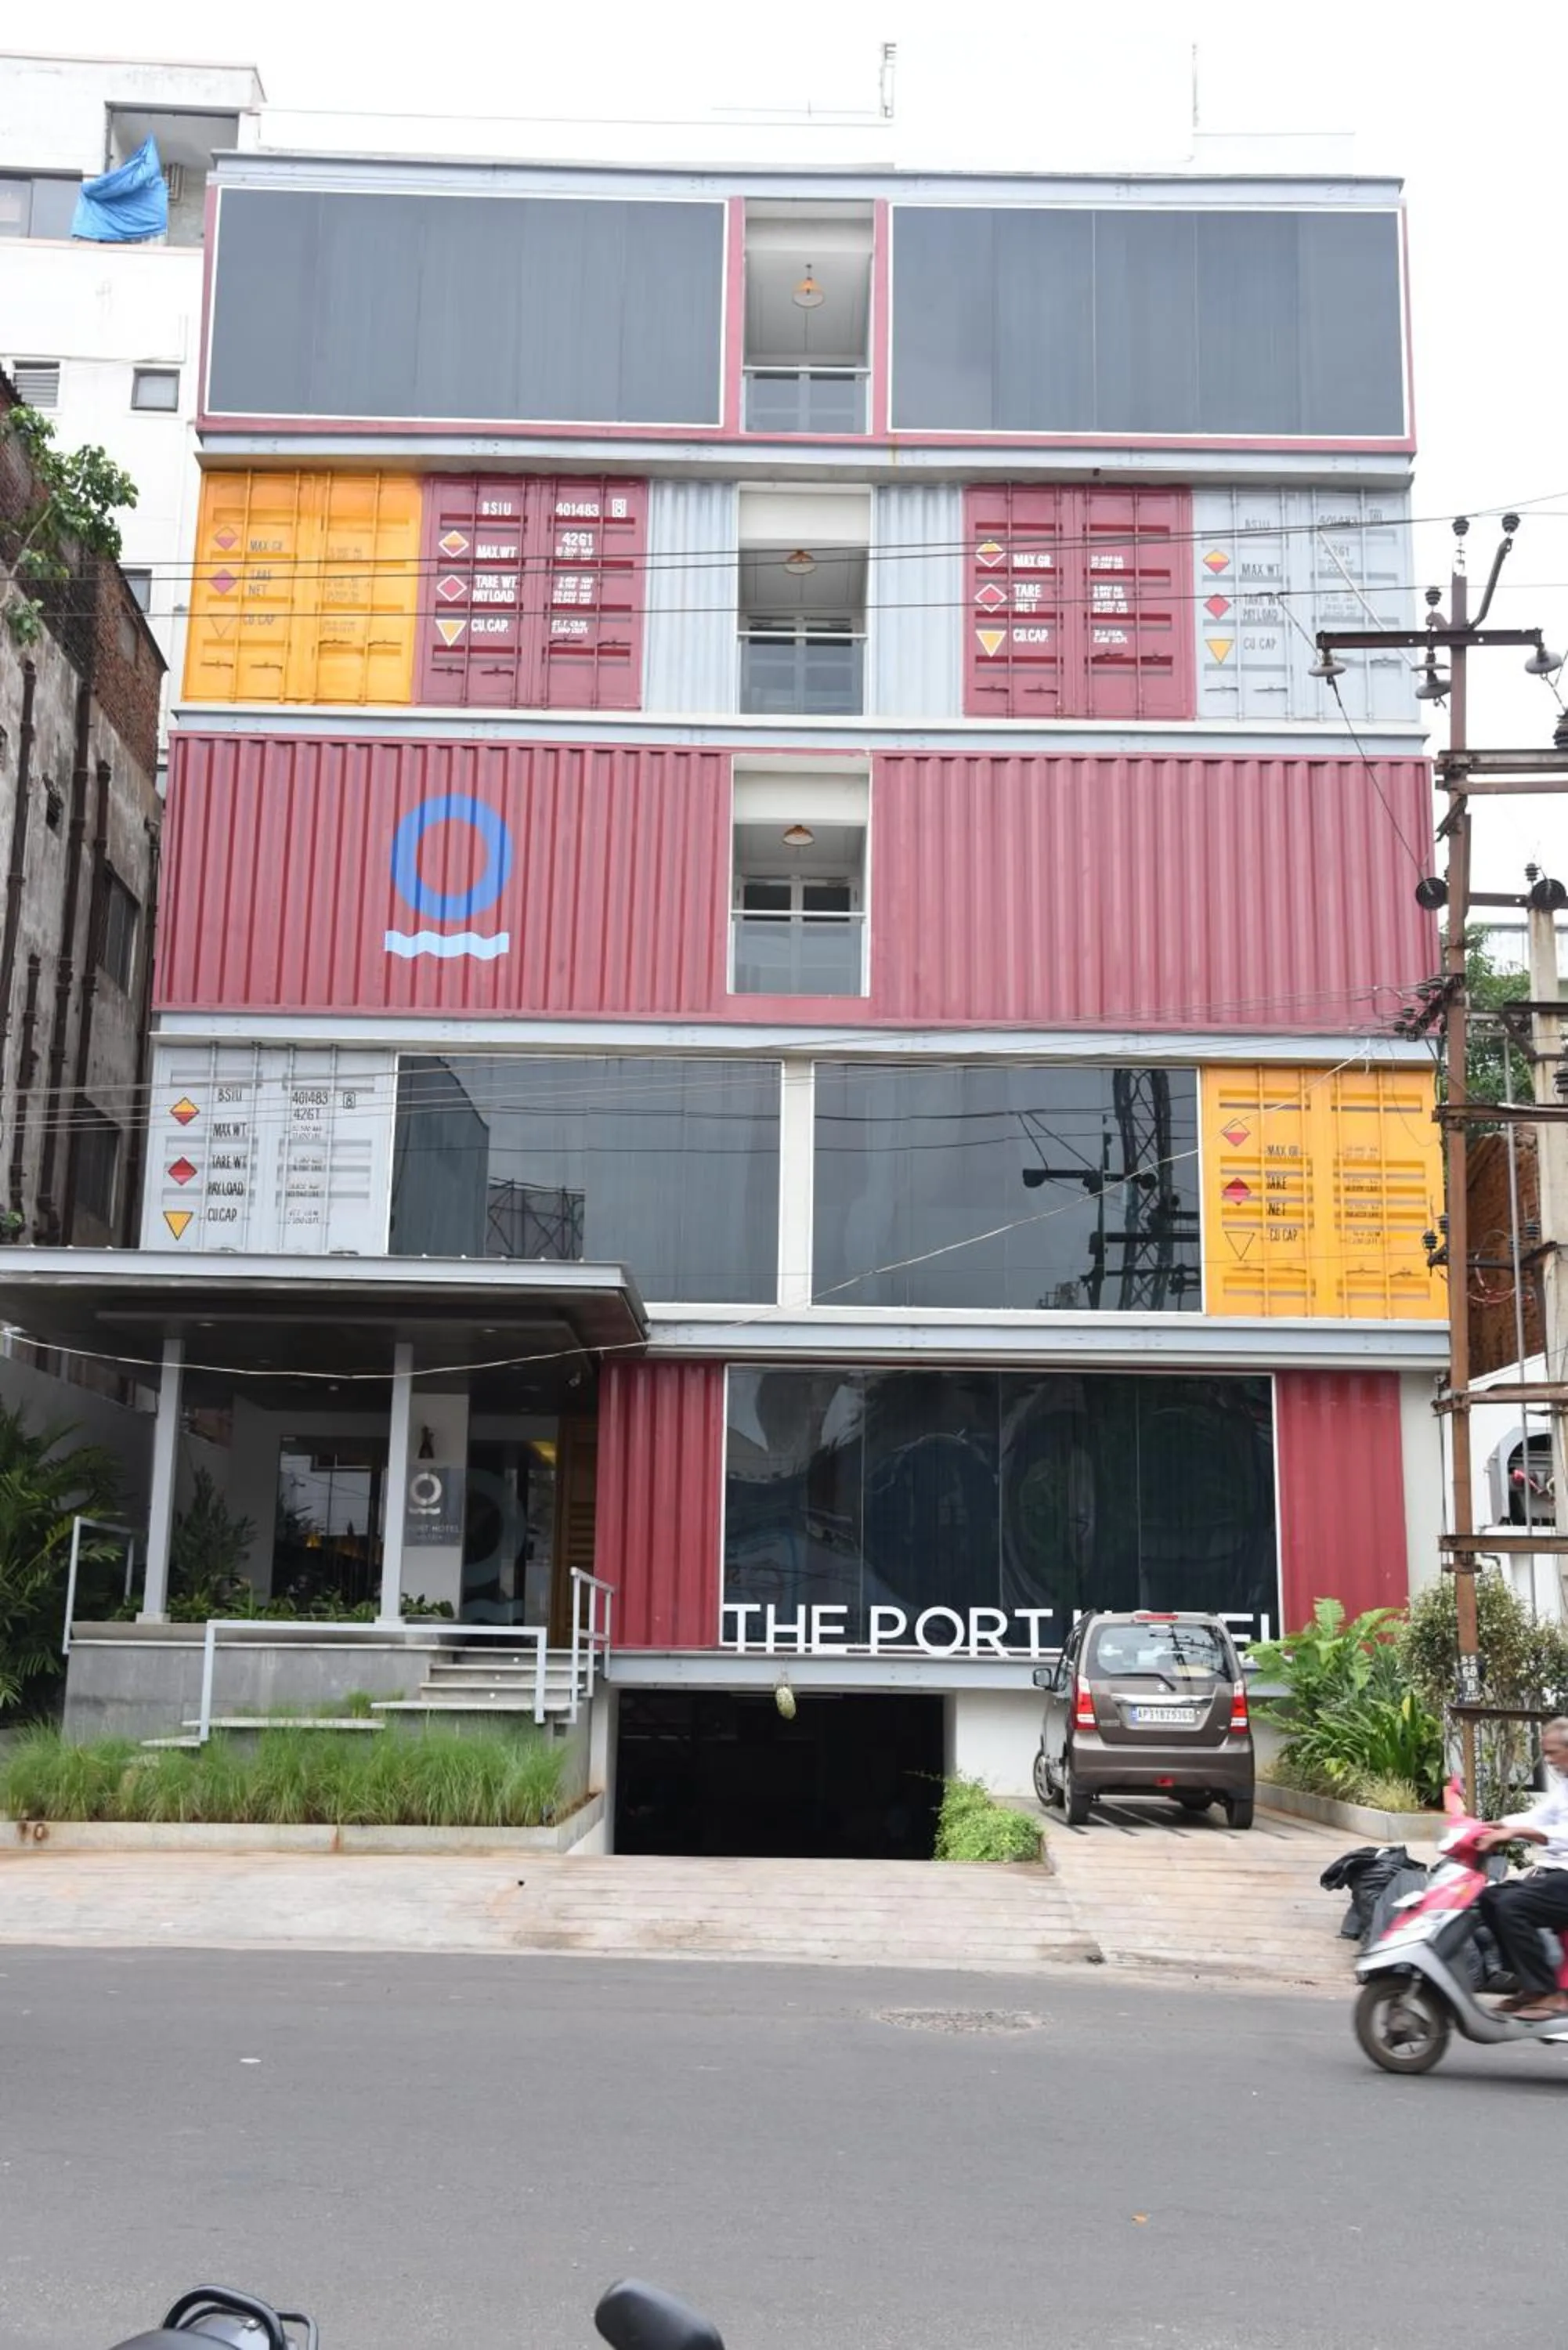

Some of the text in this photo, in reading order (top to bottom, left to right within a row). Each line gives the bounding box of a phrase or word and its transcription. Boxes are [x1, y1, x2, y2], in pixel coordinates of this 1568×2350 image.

[555, 502, 599, 516] 401483
[475, 575, 499, 588] TARE
[1015, 598, 1037, 612] NET
[292, 1091, 328, 1104] 401483
[211, 1155, 230, 1170] TARE
[1268, 1202, 1285, 1216] NET
[723, 1603, 848, 1654] THE
[869, 1605, 1053, 1658] PORT
